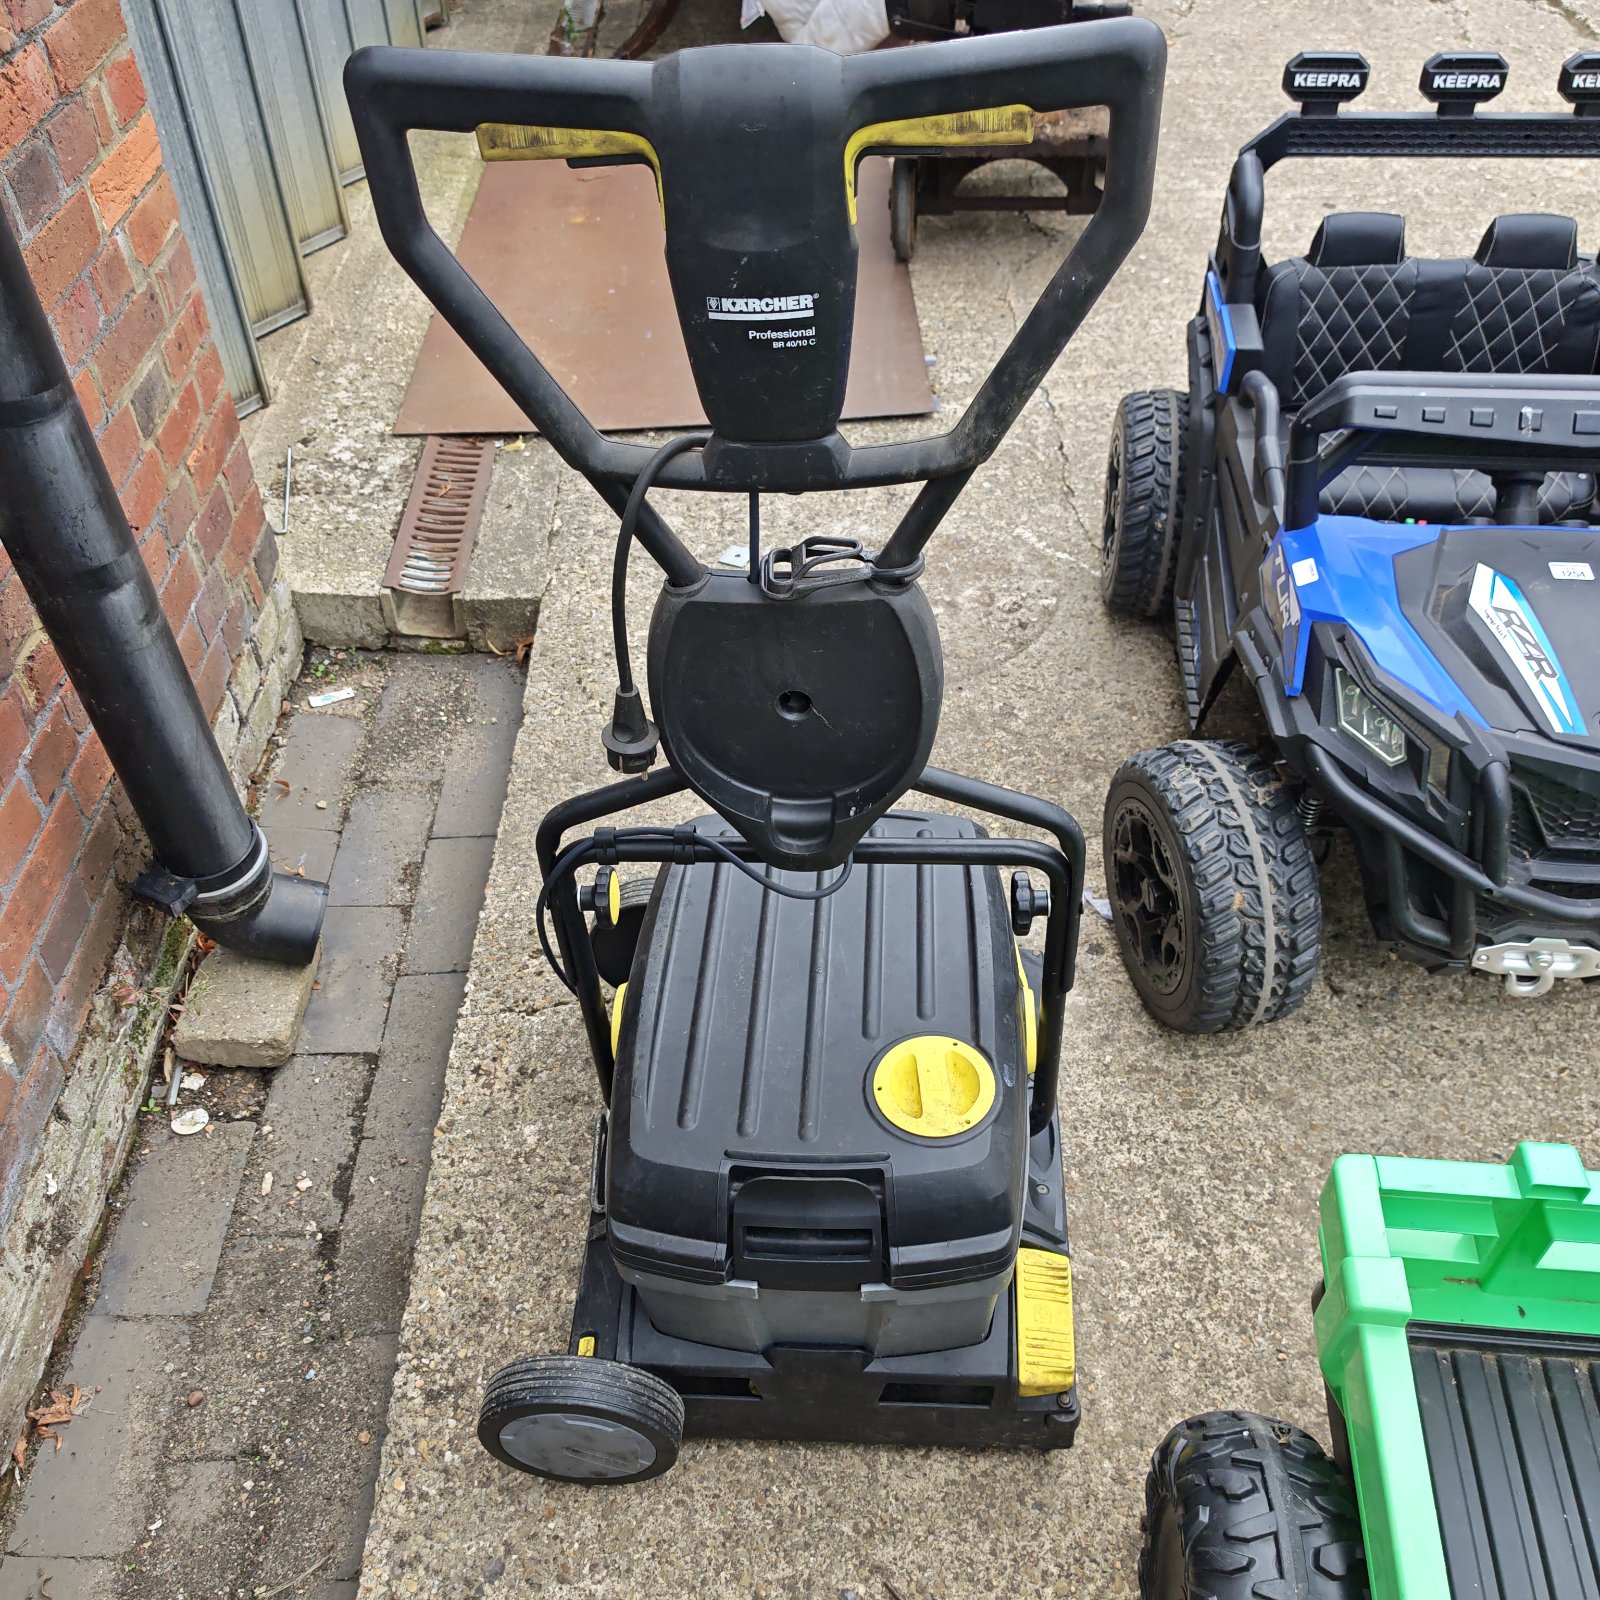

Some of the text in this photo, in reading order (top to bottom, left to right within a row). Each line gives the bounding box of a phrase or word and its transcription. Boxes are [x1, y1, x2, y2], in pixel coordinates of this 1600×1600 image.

[1293, 73, 1361, 88] KEEPRA
[1433, 74, 1501, 89] KEEPRA
[721, 294, 814, 312] KÄRCHER
[748, 326, 816, 340] Professional
[772, 338, 816, 349] BR 40/10 C
